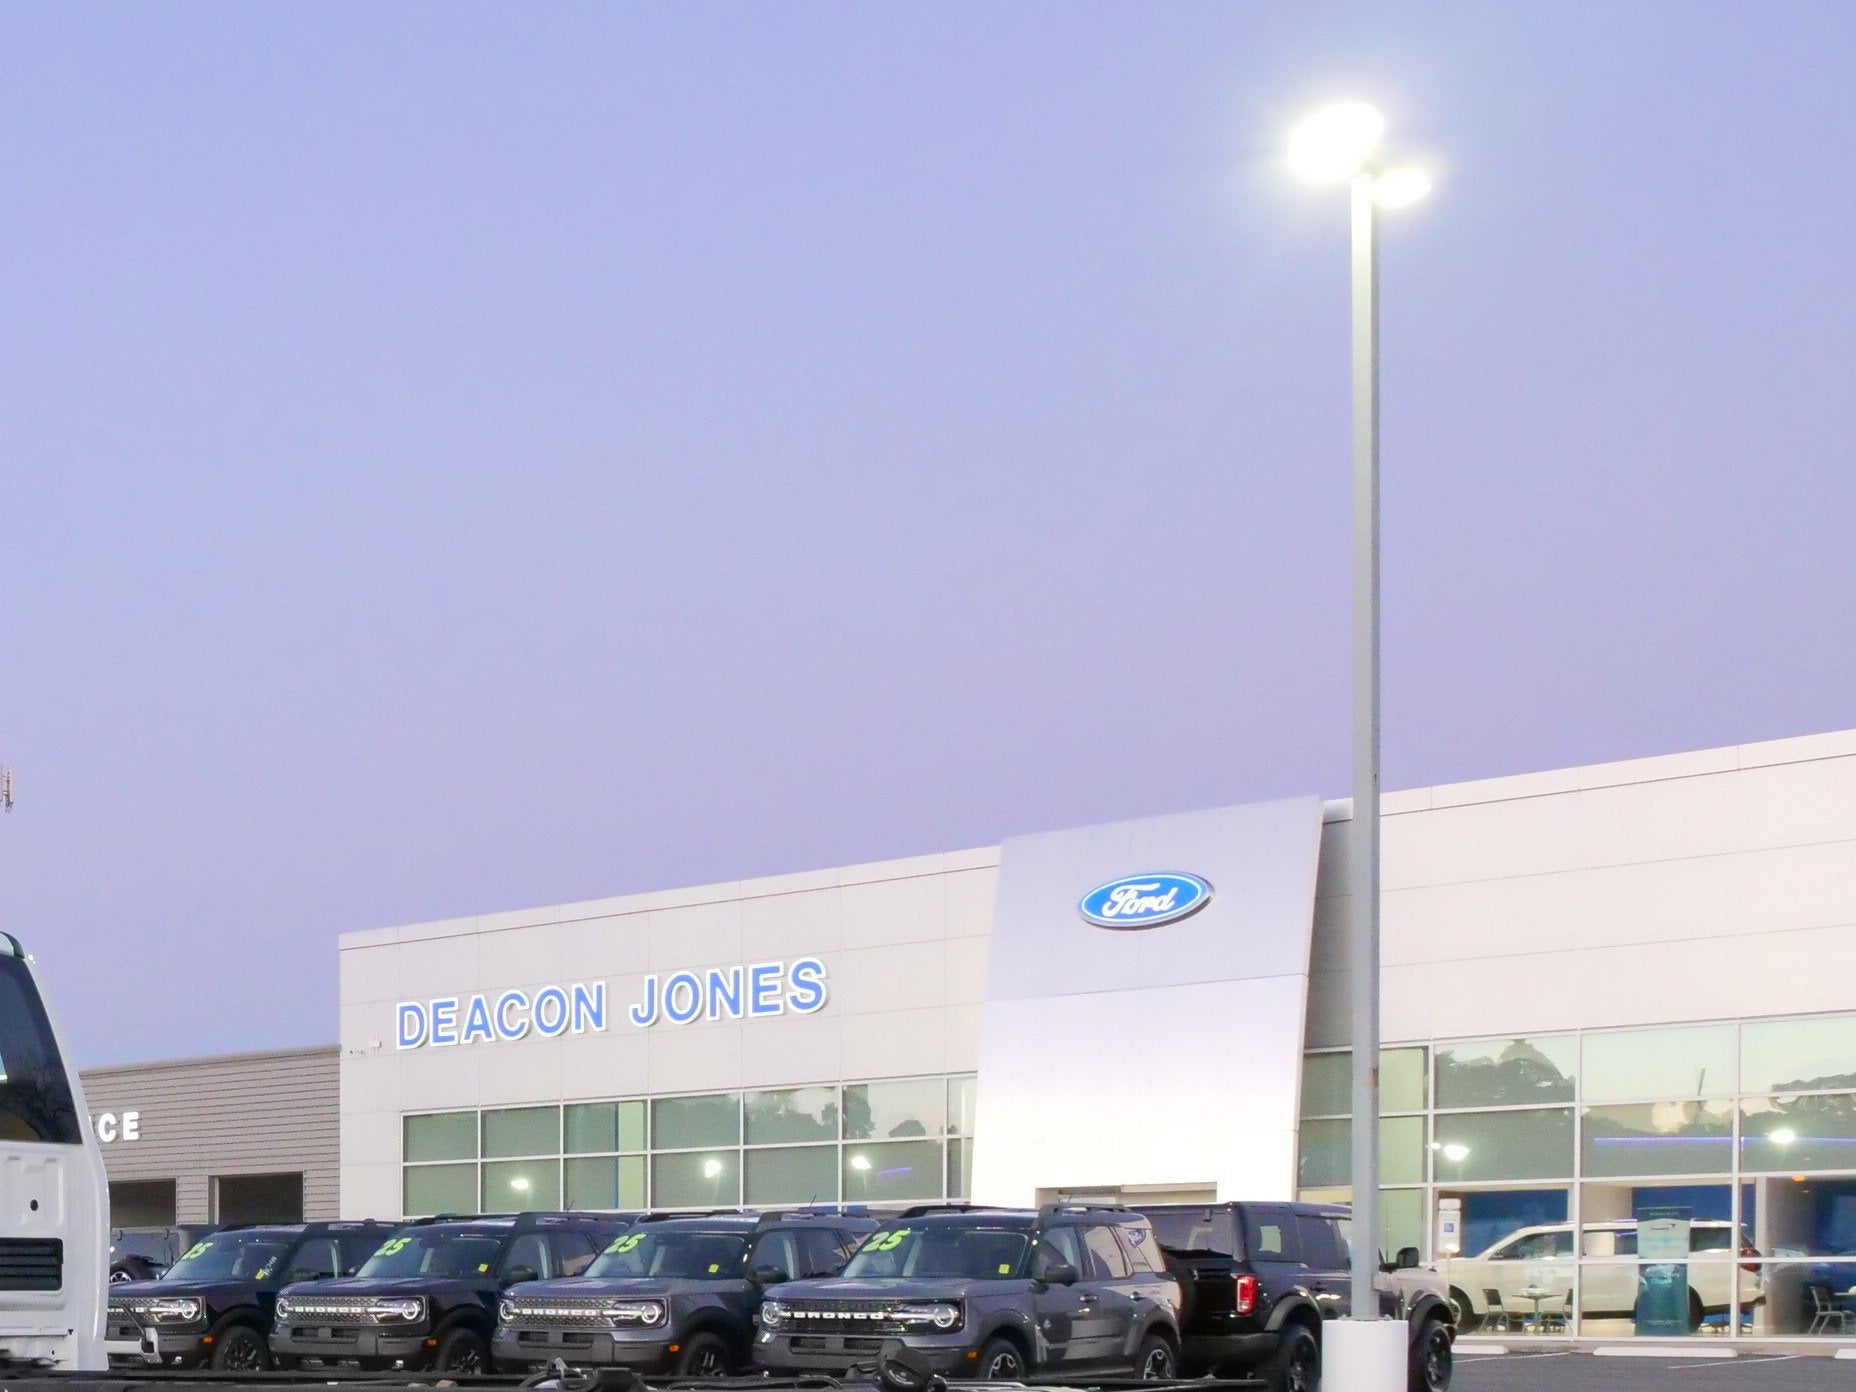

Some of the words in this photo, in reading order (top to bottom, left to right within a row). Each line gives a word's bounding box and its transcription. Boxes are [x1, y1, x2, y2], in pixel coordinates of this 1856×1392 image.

[1101, 882, 1178, 917] Ford
[395, 981, 607, 1050] DEACON
[629, 956, 827, 1028] JONES
[373, 1237, 412, 1257] 25
[603, 1233, 648, 1254] 25
[861, 1228, 912, 1252] 25
[294, 1306, 362, 1314] BRONCO
[521, 1307, 597, 1316] BRONCO
[793, 1311, 885, 1320] BRONCO
